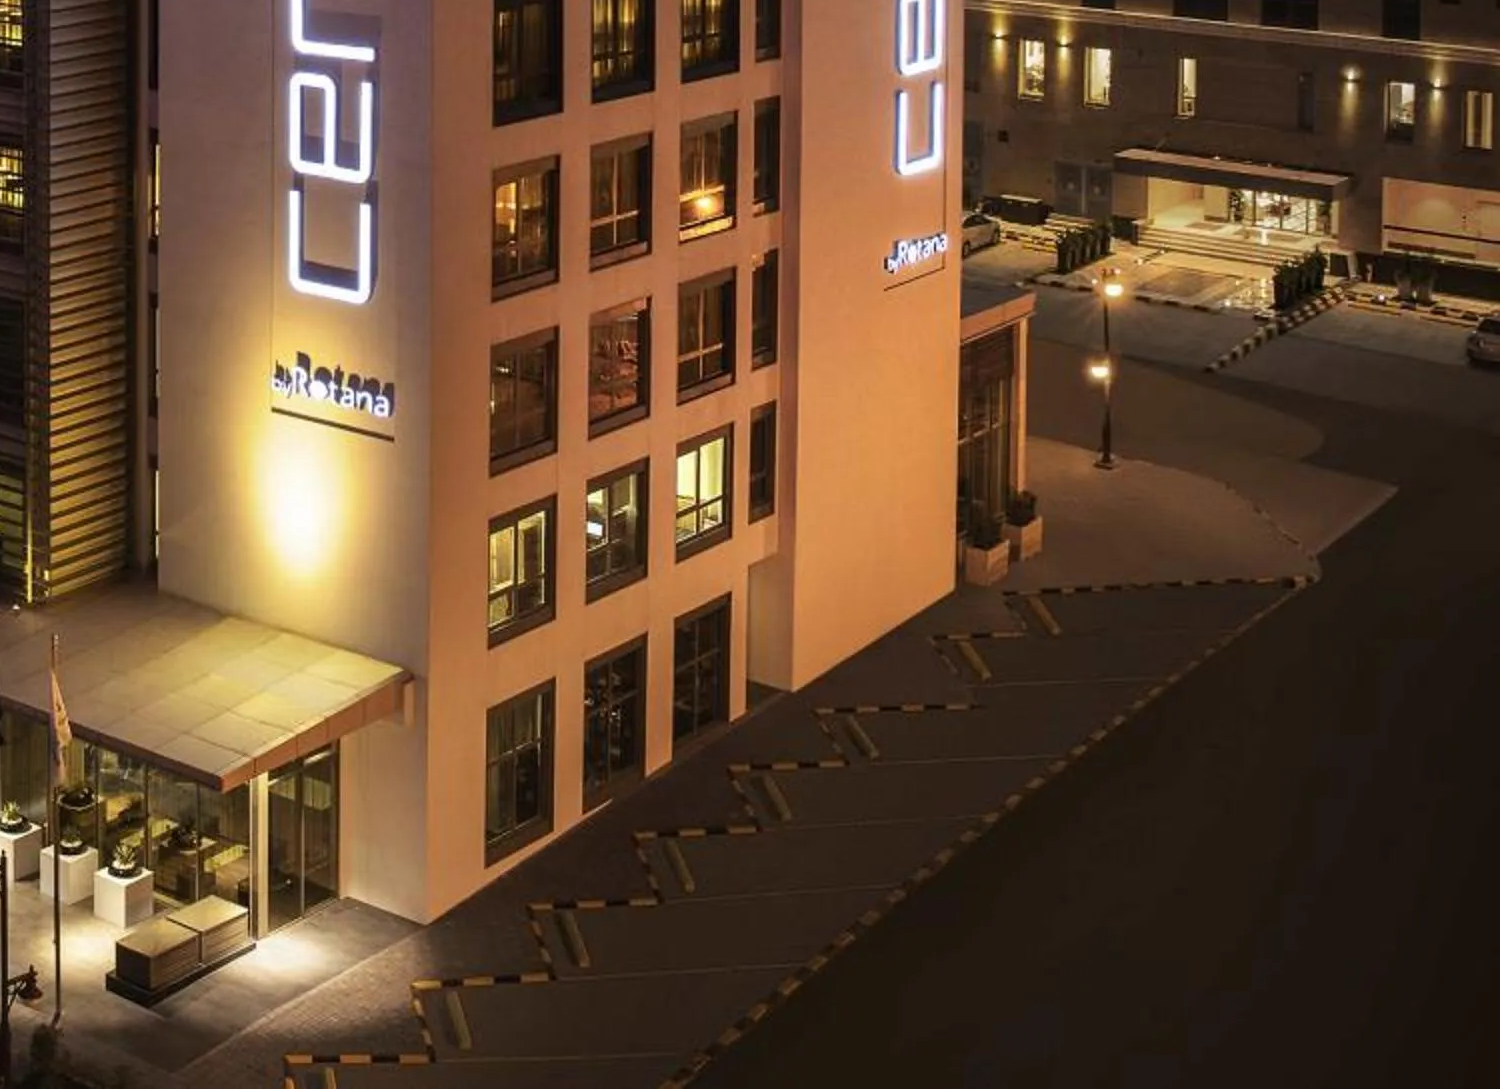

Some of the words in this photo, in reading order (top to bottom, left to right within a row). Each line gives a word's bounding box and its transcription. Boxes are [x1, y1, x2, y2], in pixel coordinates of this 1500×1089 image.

[897, 233, 949, 267] Rotana
[271, 374, 293, 399] by
[291, 365, 391, 419] Rotana
